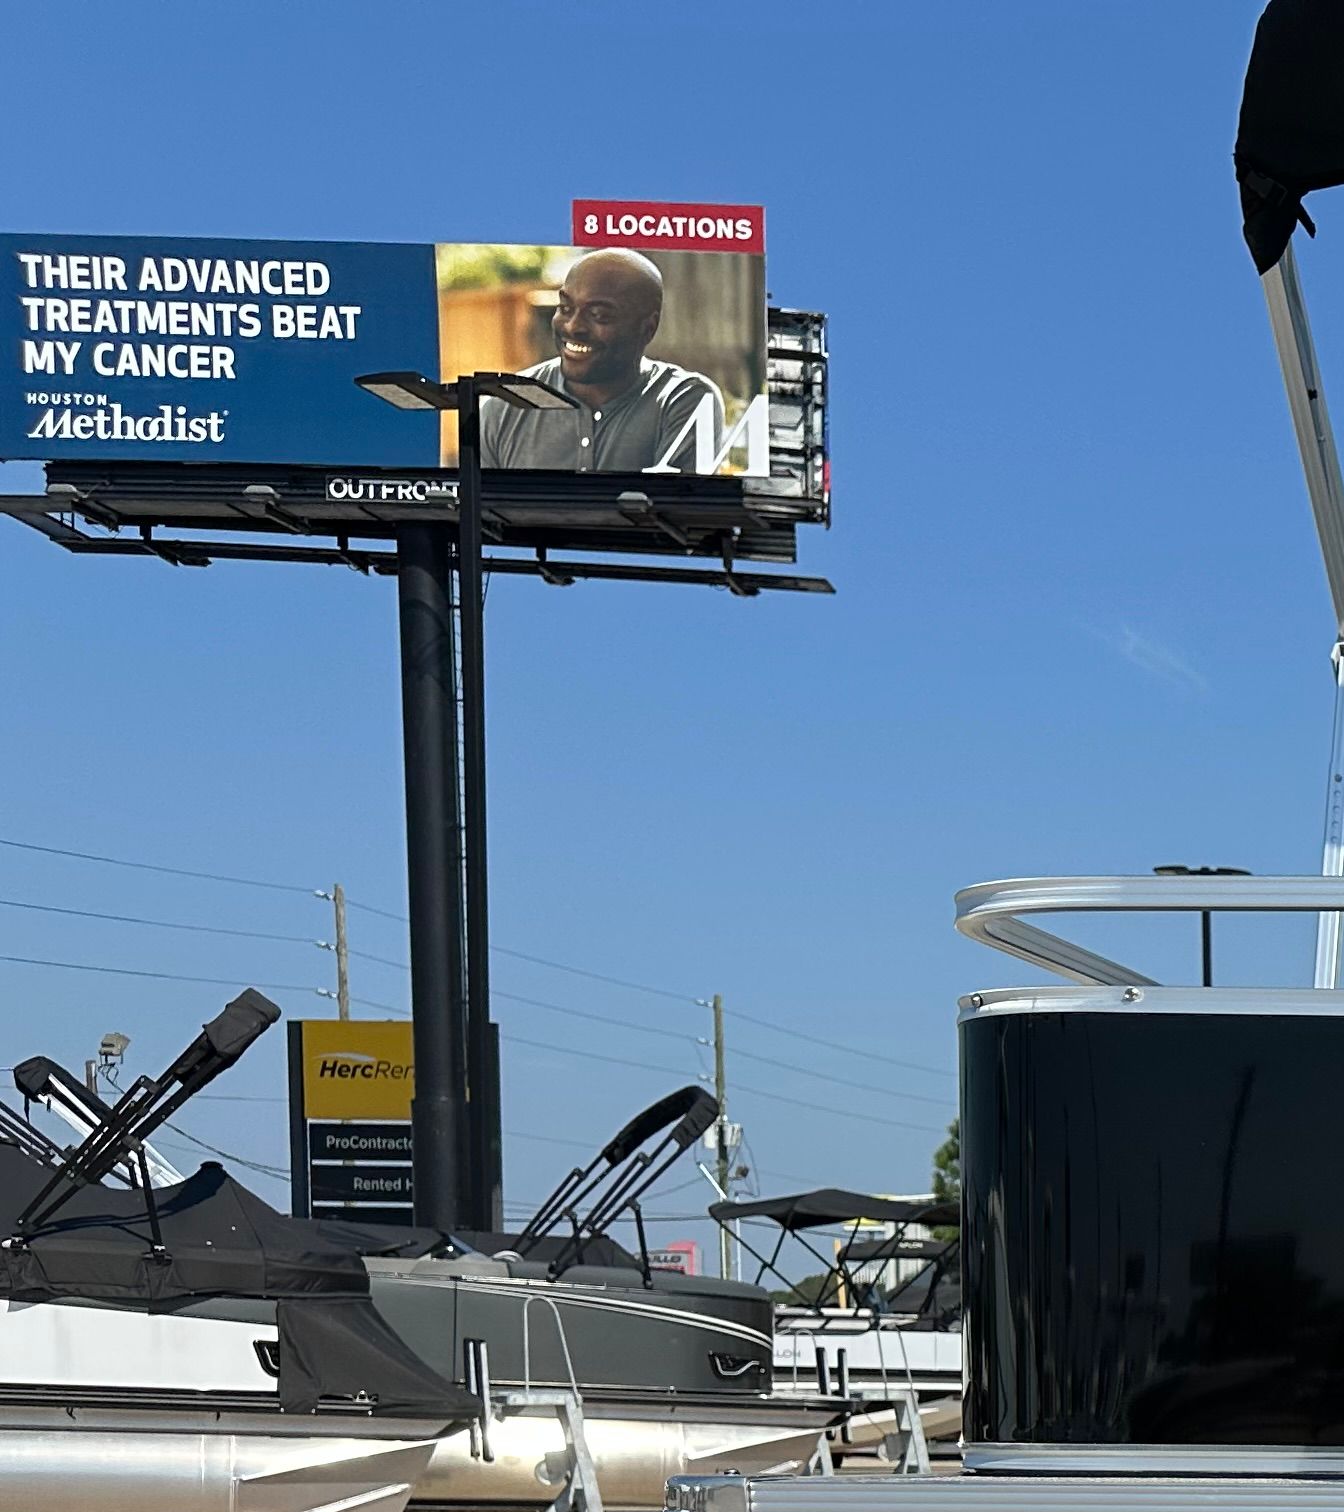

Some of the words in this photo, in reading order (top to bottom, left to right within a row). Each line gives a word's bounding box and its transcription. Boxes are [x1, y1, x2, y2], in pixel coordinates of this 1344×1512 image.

[584, 214, 599, 235] 8
[606, 214, 753, 240] LOCATIONS
[20, 253, 128, 291] THEIR
[138, 257, 331, 296] ADVANCED
[22, 297, 262, 338] TREATMENTS
[273, 304, 361, 339] BEAT
[24, 341, 82, 375] MY
[93, 343, 236, 379] CANCER
[27, 392, 108, 406] HOUSTON
[28, 403, 226, 442] Methodist
[353, 1176, 402, 1192] Rented
